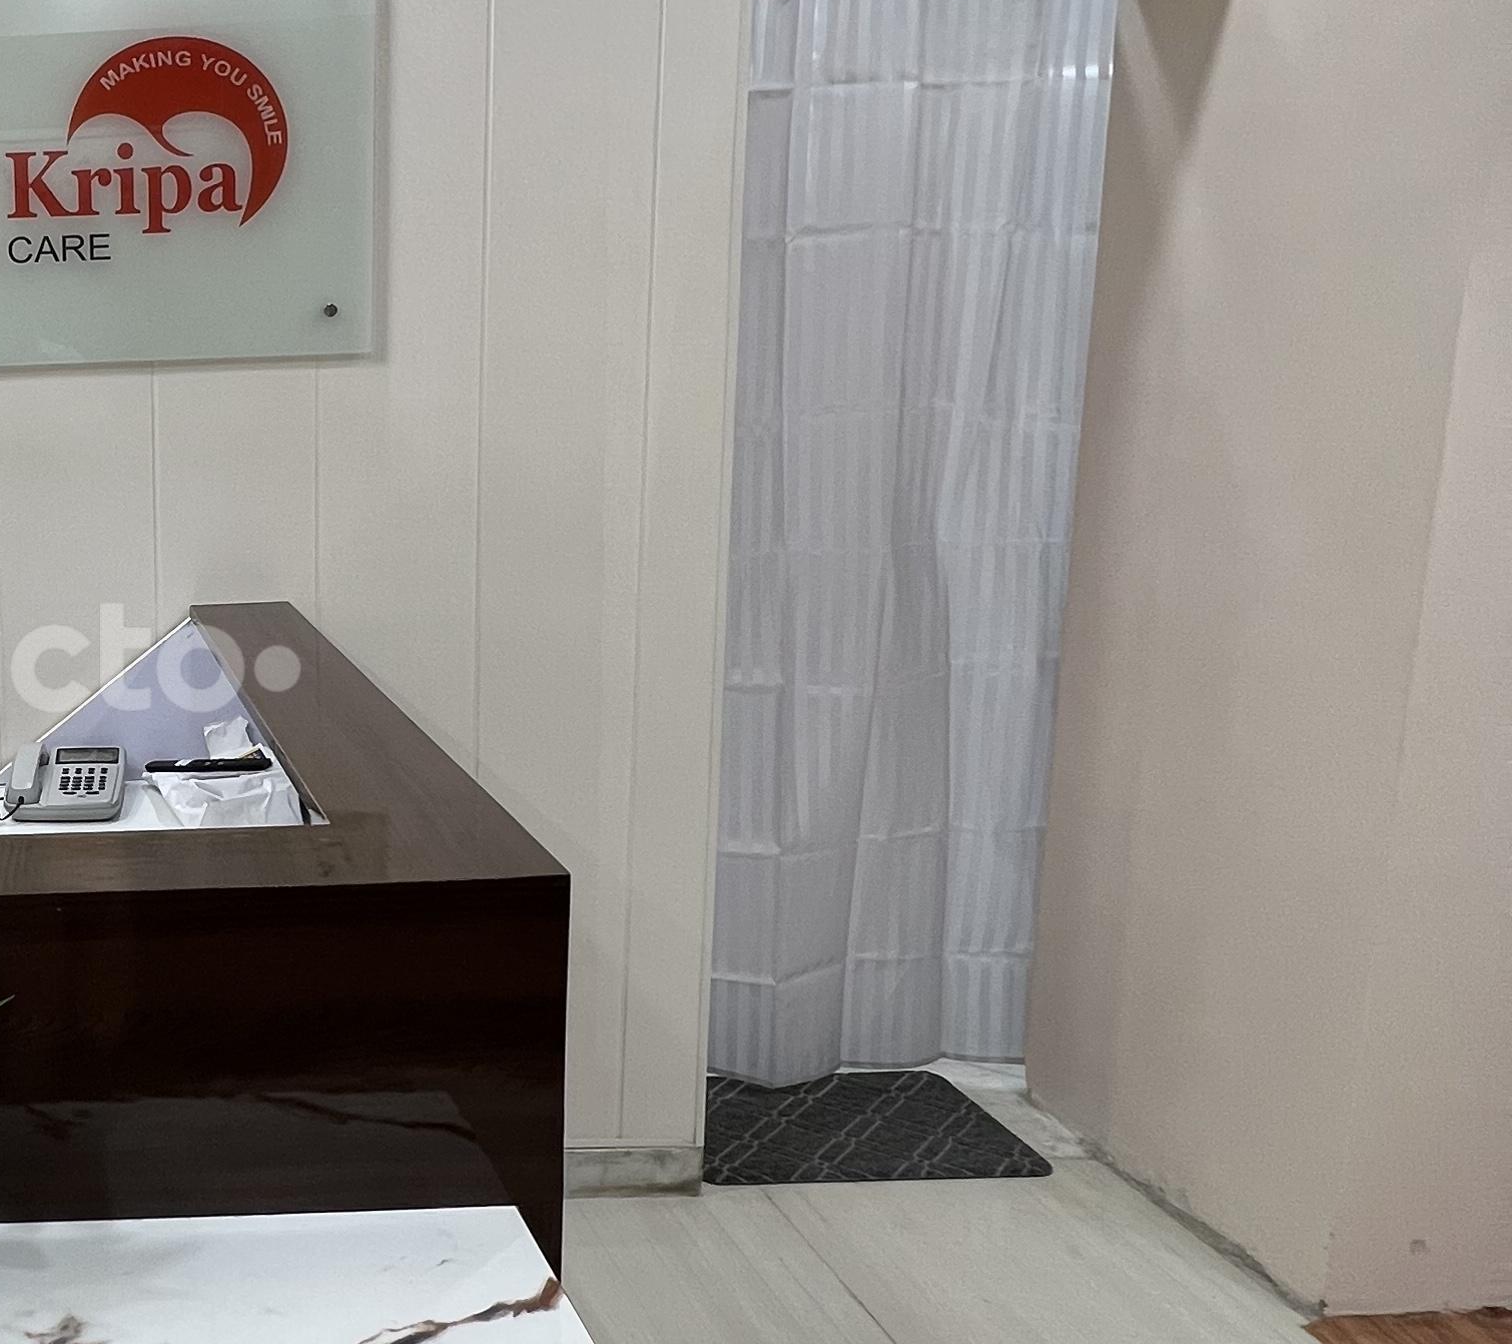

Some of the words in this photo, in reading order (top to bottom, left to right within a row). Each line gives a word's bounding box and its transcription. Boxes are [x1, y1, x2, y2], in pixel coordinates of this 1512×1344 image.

[99, 50, 192, 91] MAKING
[201, 53, 248, 87] YOU
[246, 83, 283, 146] SMILE
[5, 142, 243, 234] Kripa
[6, 233, 112, 265] CARE
